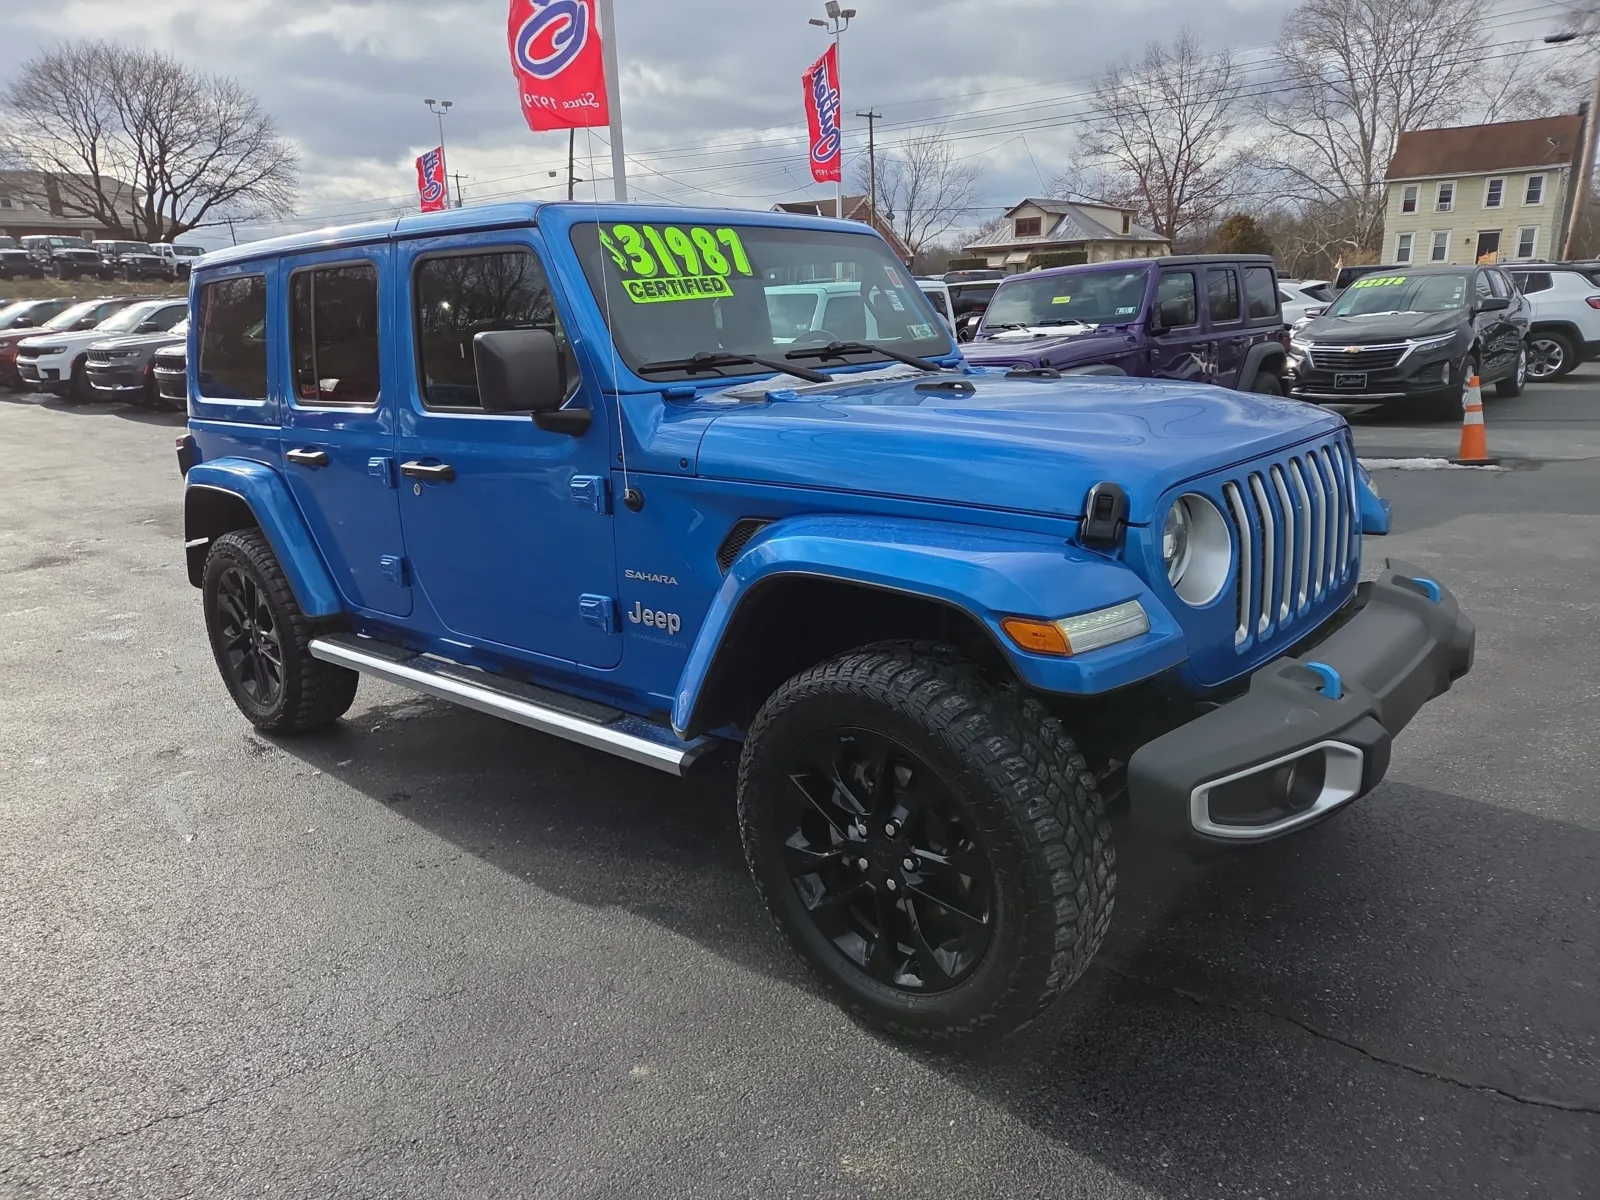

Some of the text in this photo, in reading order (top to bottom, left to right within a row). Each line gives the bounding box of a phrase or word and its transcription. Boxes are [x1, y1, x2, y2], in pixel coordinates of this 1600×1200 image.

[600, 224, 753, 277] $31987
[628, 276, 726, 299] CERTIFIED
[625, 569, 678, 585] SAHARA
[628, 601, 680, 635] Jeep
